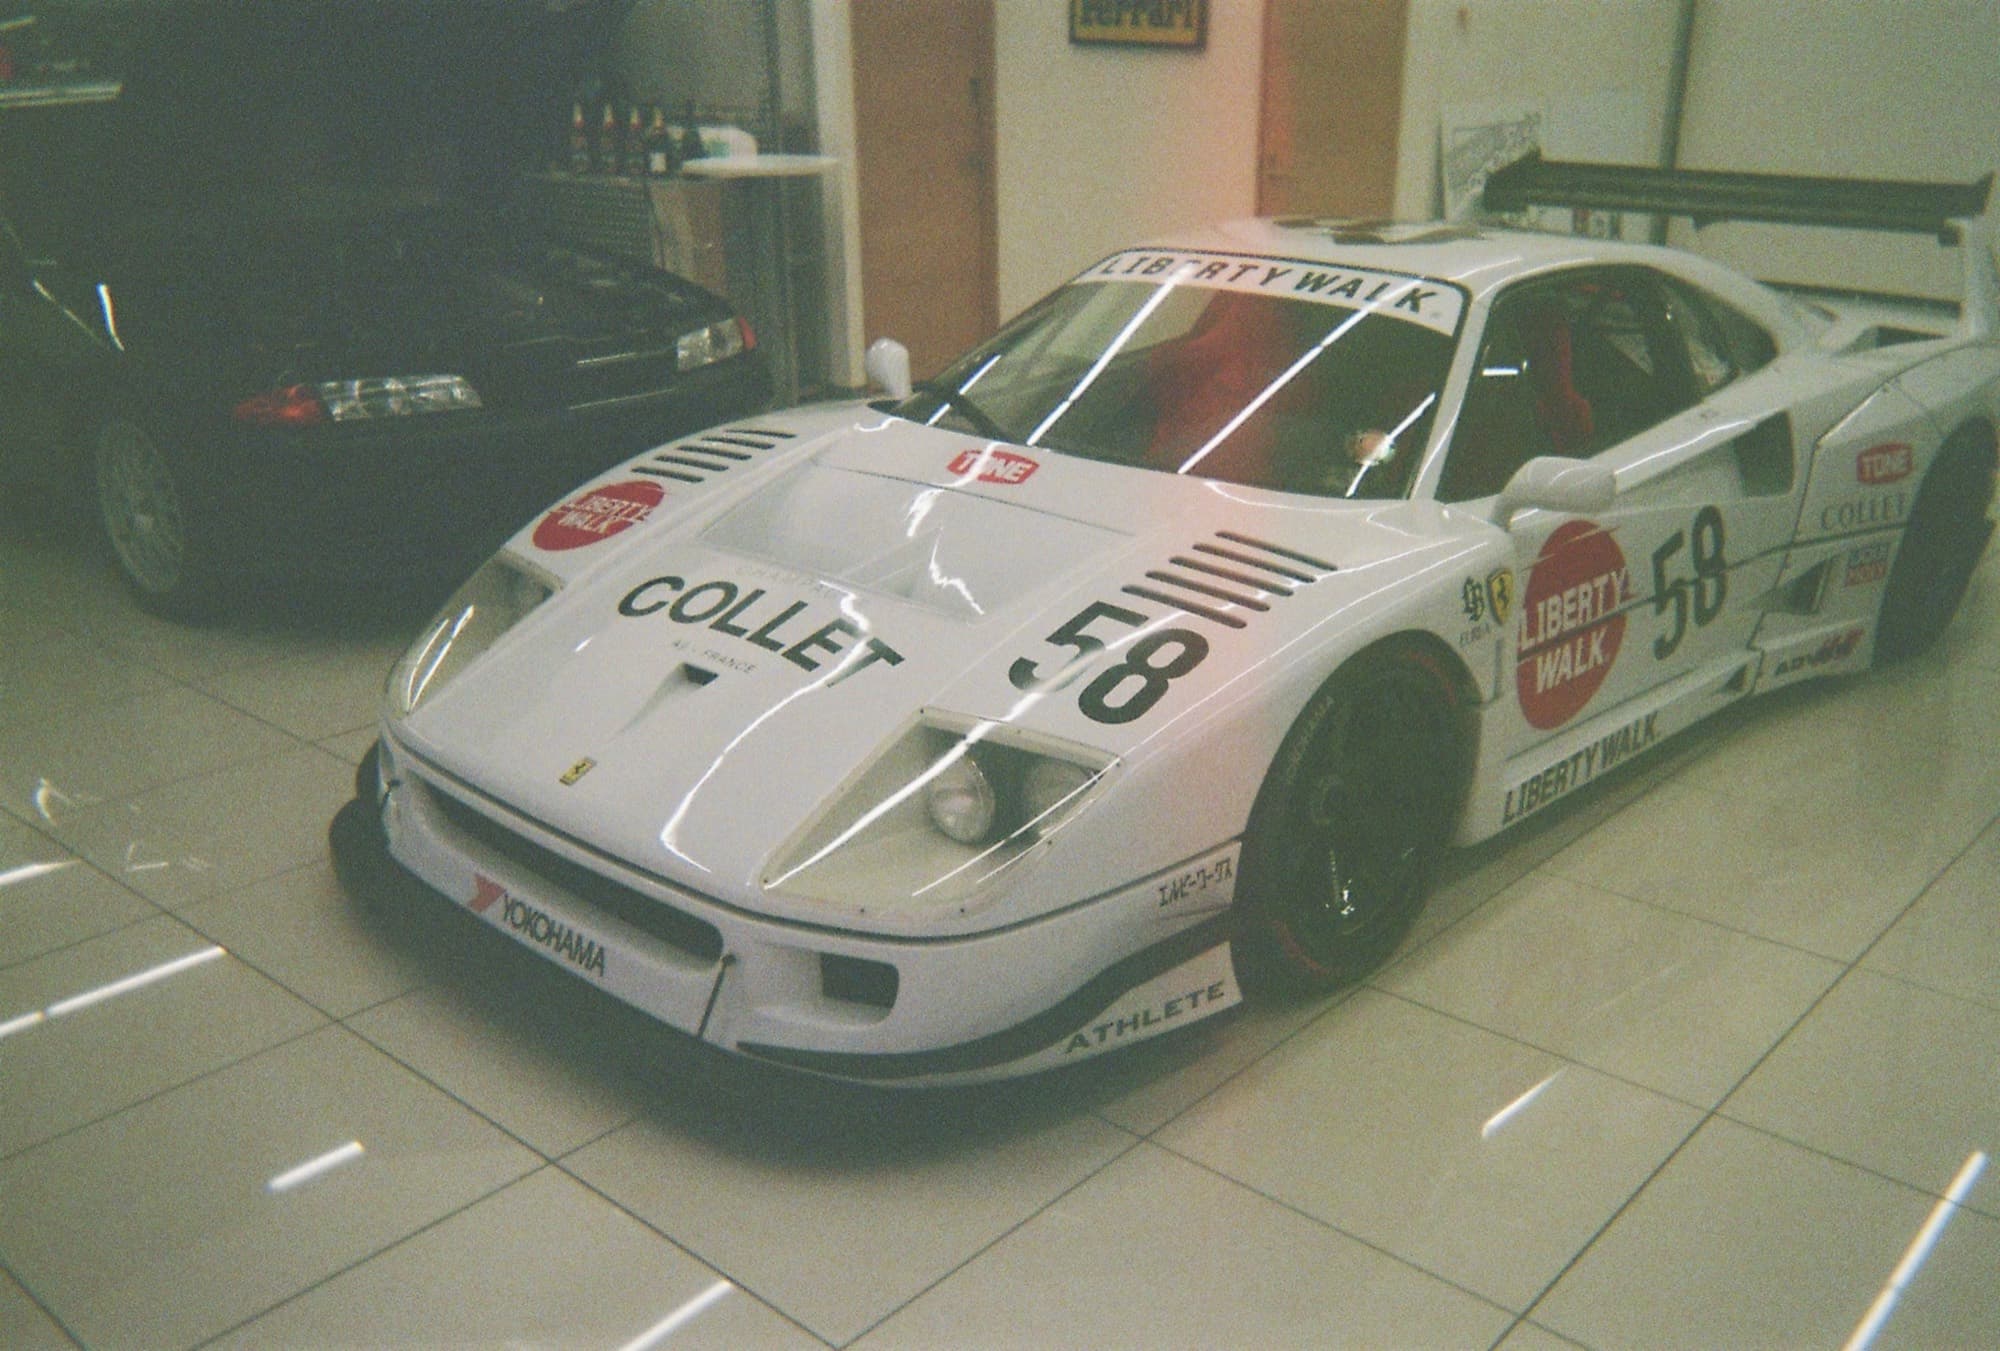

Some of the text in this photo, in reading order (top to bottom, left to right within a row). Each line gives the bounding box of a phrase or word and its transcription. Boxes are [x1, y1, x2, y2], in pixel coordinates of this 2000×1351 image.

[617, 575, 905, 688] COLLET
[1518, 566, 1630, 650] LIBERTY
[1652, 505, 1728, 661] 58
[1008, 600, 1210, 725] 58
[1534, 624, 1609, 694] WALK
[1502, 710, 1658, 827] LIBERTY WALK
[503, 891, 605, 978] YOKOHAMA
[1065, 979, 1225, 1055] ATHLETE
